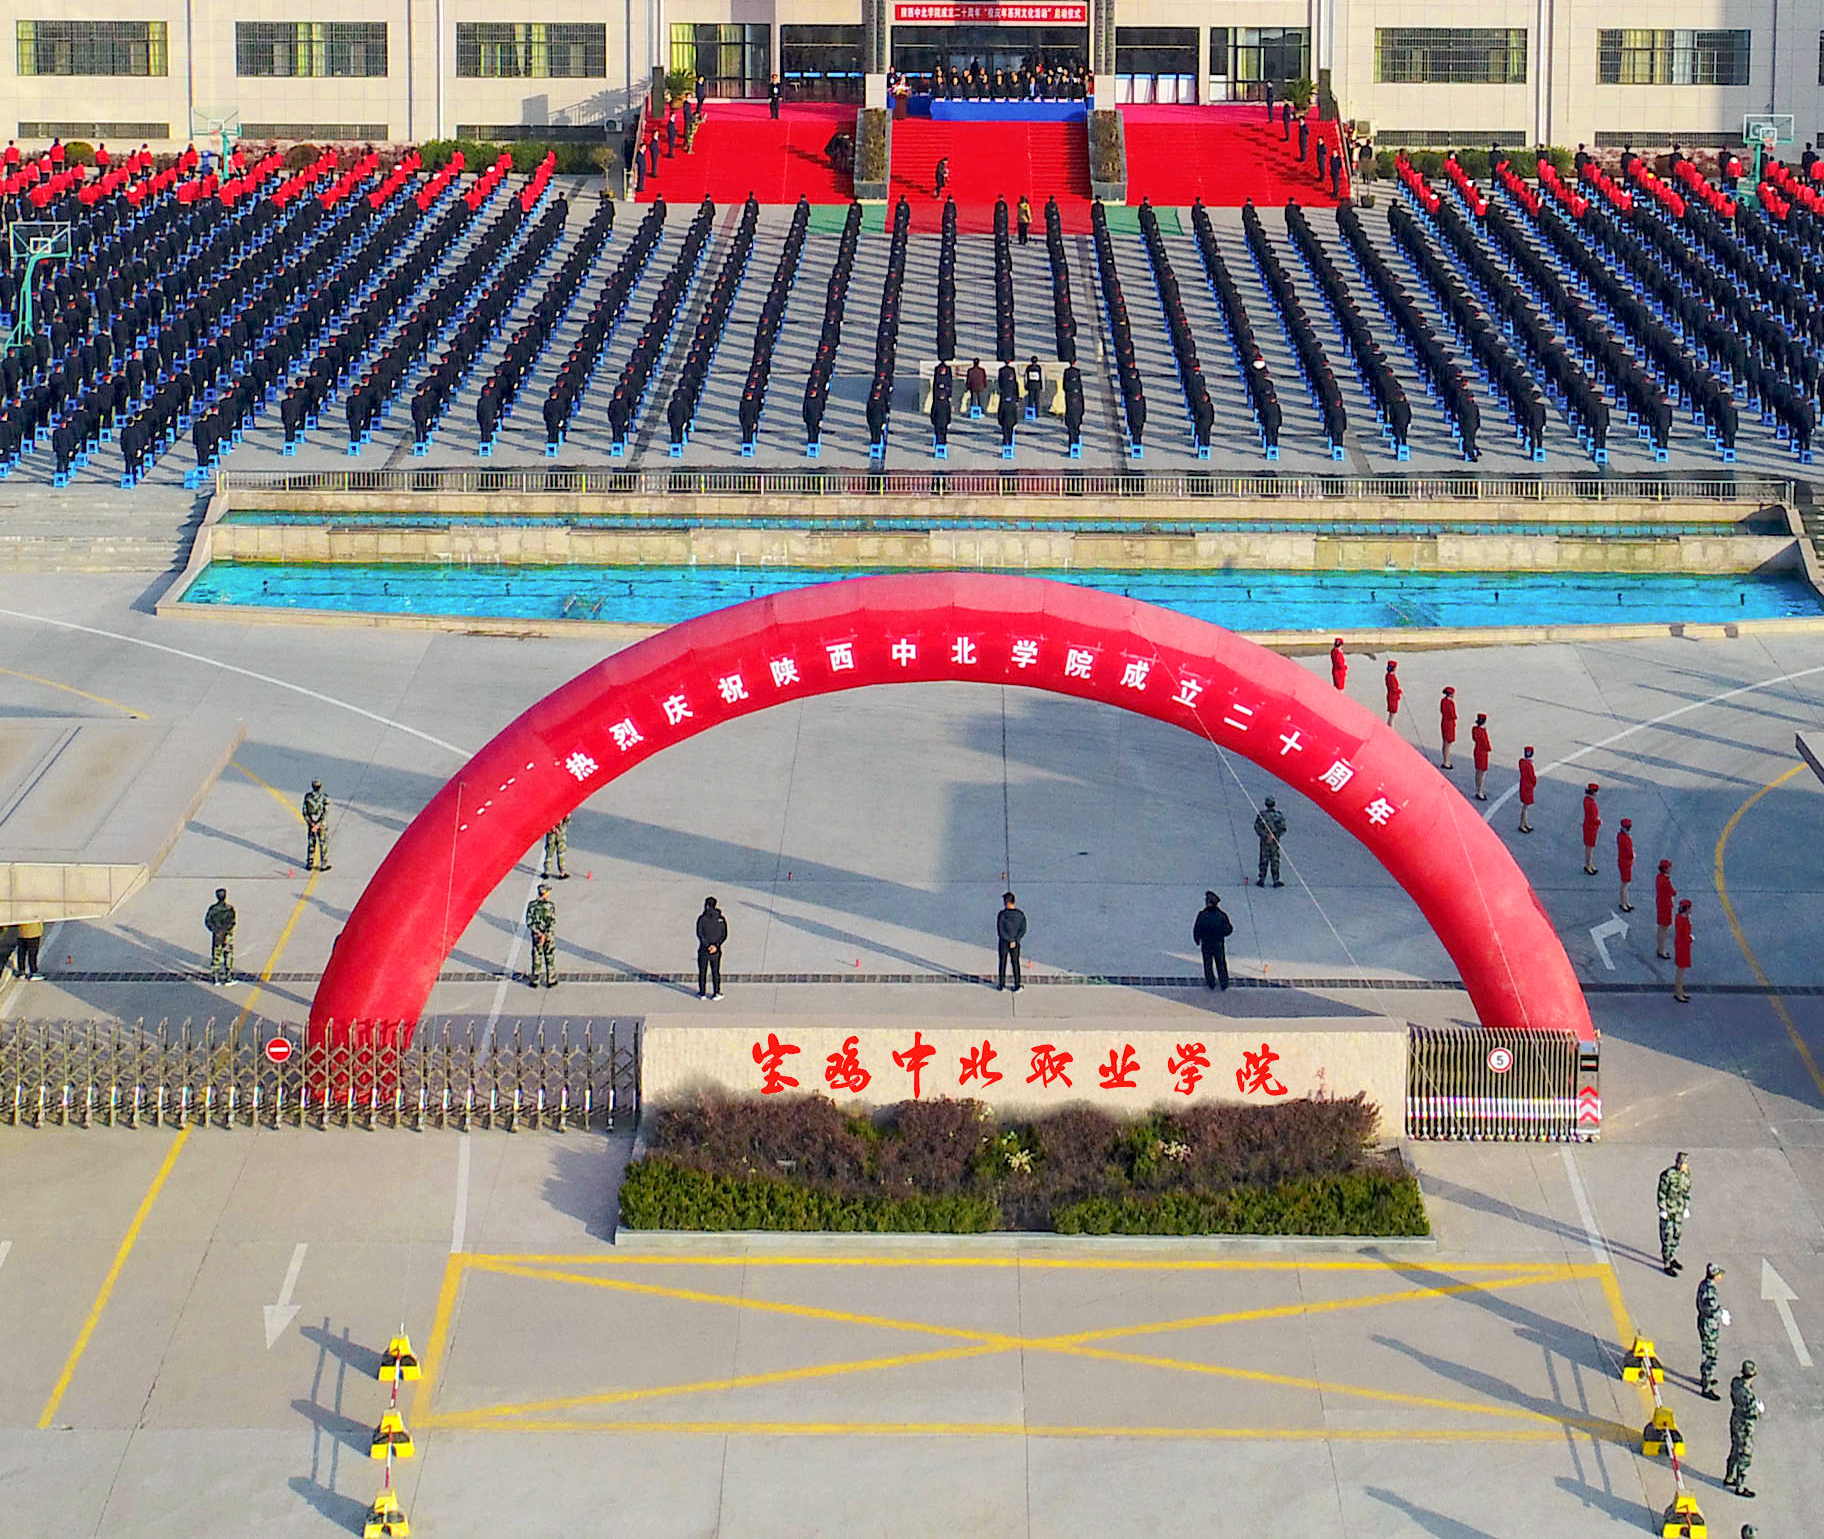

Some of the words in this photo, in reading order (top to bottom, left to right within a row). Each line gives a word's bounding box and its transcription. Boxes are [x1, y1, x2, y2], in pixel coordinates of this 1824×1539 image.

[565, 634, 1395, 826] 热烈庆祝陕西中北学院成立二十周年
[751, 1031, 1289, 1100] 宝鸡中北职业学院
[1495, 1055, 1504, 1066] 5
